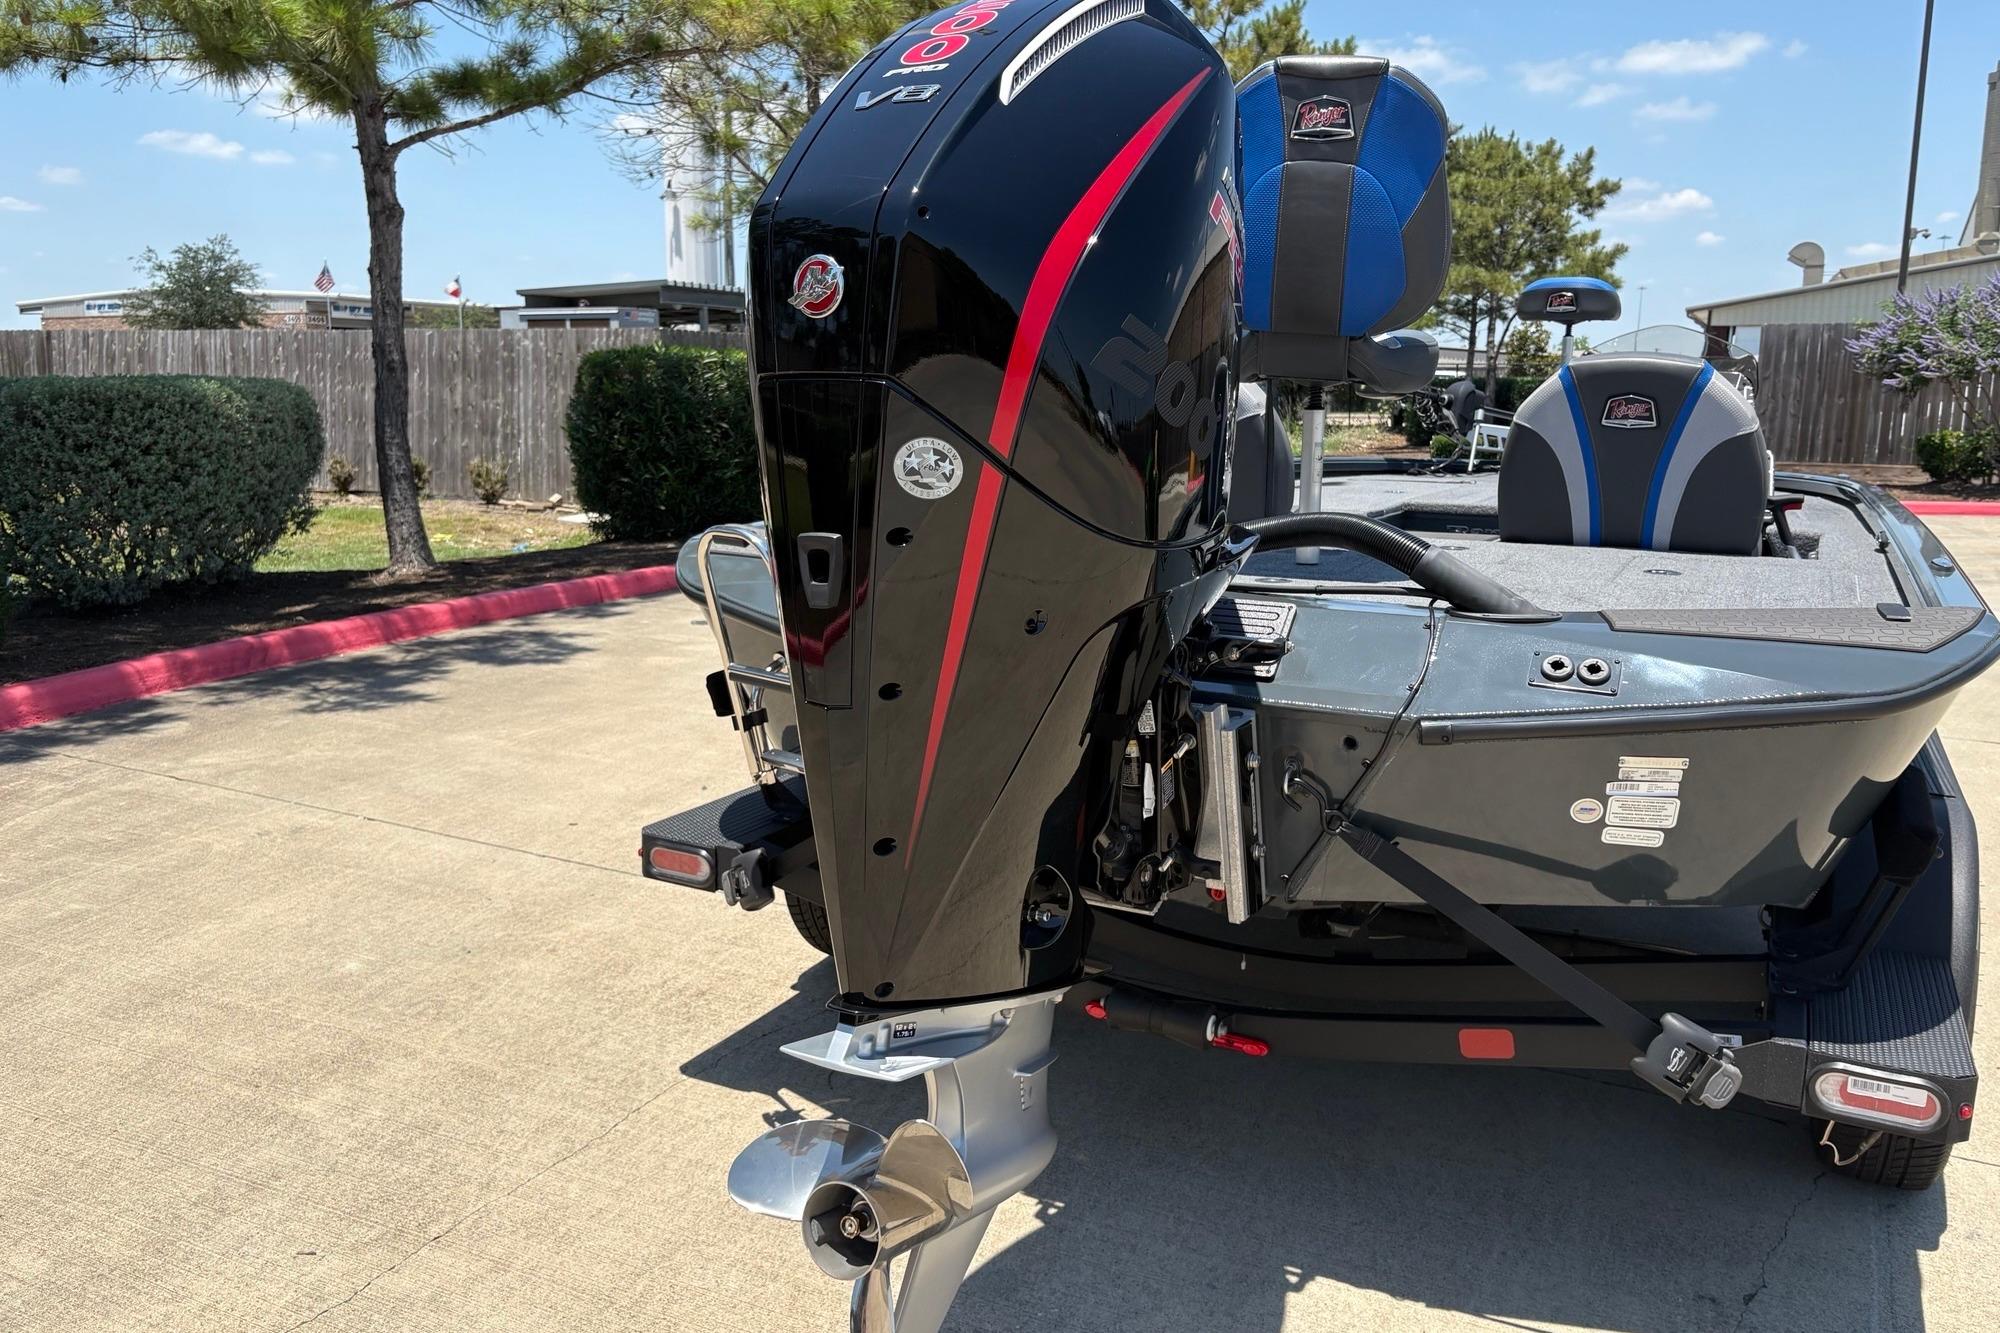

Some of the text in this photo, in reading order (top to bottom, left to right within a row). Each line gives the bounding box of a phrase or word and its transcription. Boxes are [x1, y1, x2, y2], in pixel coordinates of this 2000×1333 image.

[882, 63, 950, 78] PRO
[854, 84, 942, 111] V8
[1300, 102, 1346, 129] Ranger
[1610, 400, 1649, 418] Ranger
